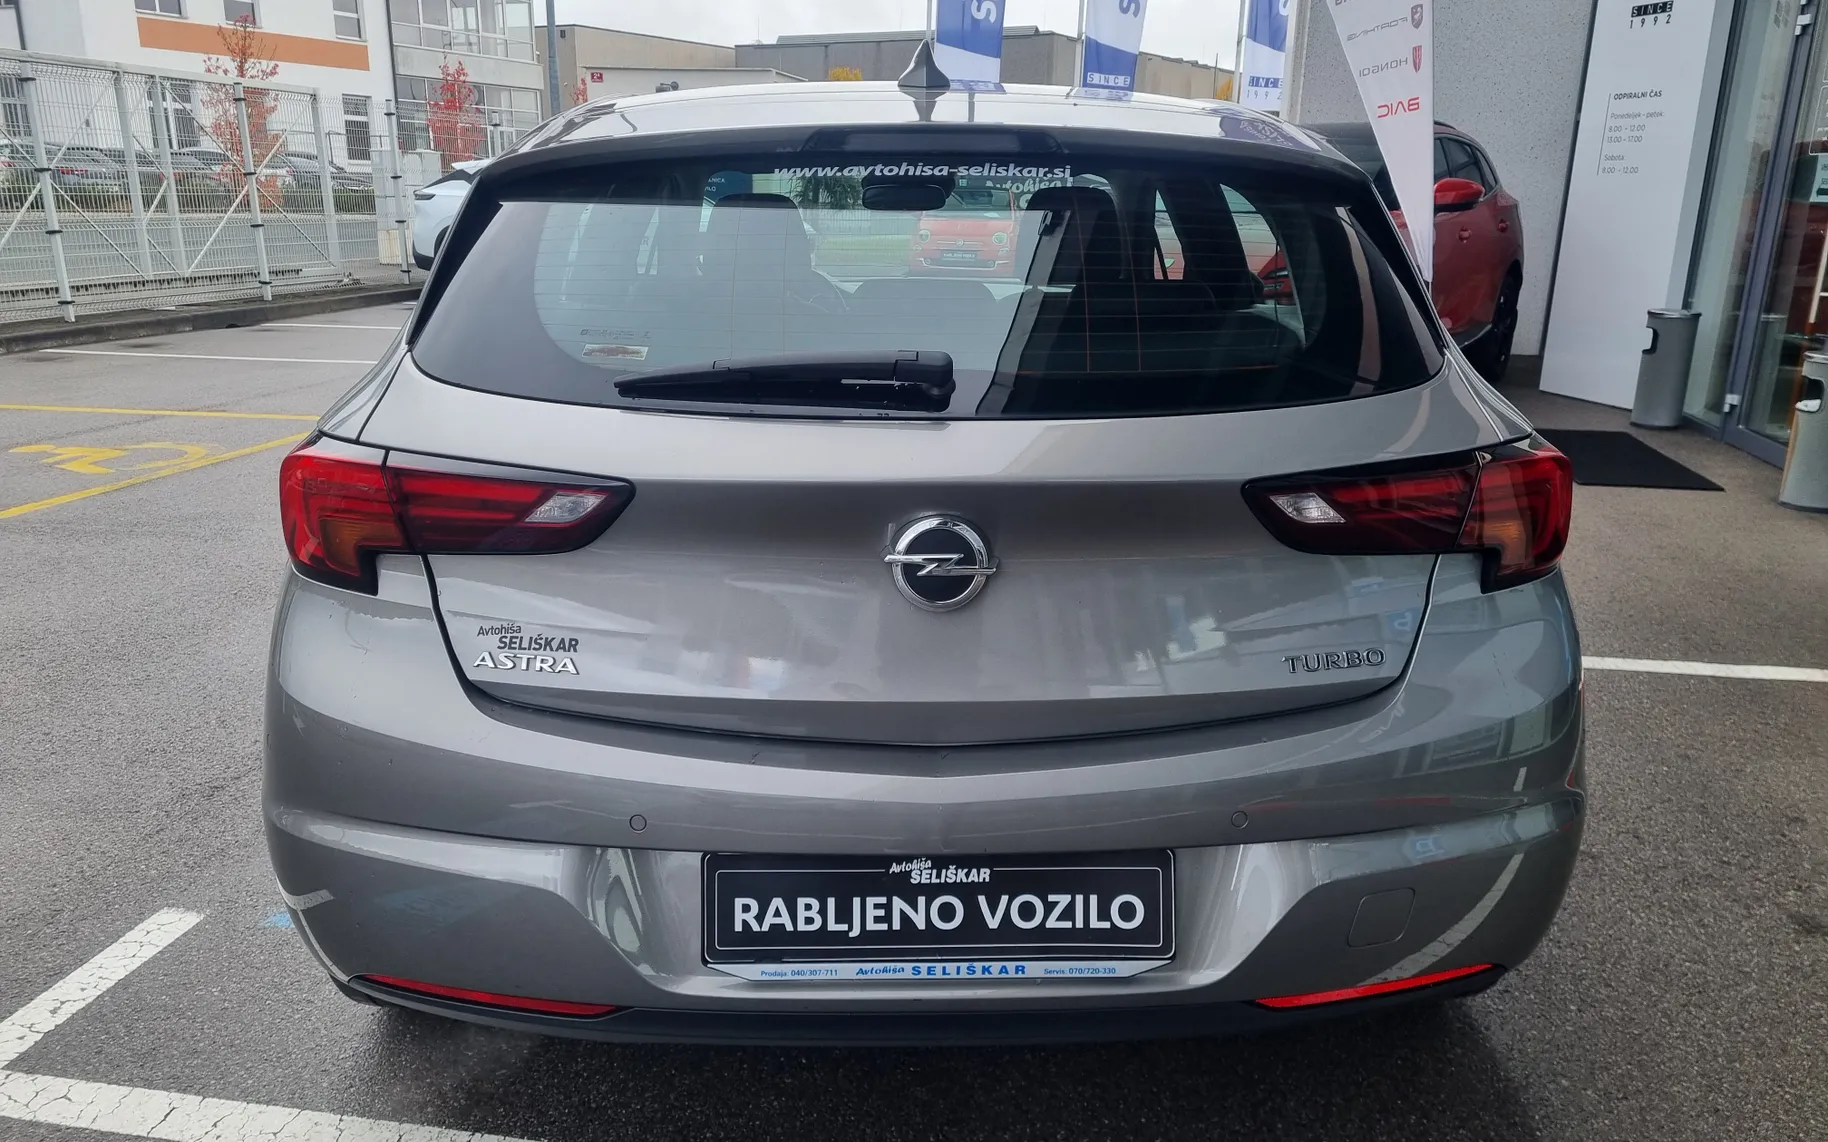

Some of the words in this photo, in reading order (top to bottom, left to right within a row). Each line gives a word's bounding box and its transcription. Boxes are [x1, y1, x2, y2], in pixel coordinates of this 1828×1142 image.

[1632, 1, 1674, 16] SINCE
[1629, 13, 1672, 29] 1992
[1088, 73, 1130, 86] SINCE
[1613, 91, 1648, 100] ODPIRALNI
[1649, 89, 1662, 98] ČAS
[773, 162, 1072, 178] www.avtohisa-seliskar.si
[473, 651, 580, 675] ASTRA
[1281, 647, 1386, 674] TURBO
[889, 857, 932, 874] Avtohiša
[910, 865, 991, 884] SELIŠKAR
[734, 895, 964, 937] RABLJENO
[978, 894, 1145, 930] VOZILO
[760, 970, 789, 978] Prodaja:
[790, 969, 838, 977] 040/307-711
[856, 965, 905, 976] Avtohiša
[911, 963, 1026, 976] SELIŠKAR
[1043, 967, 1066, 975] Servis:
[1068, 967, 1116, 976] 070/720-330
